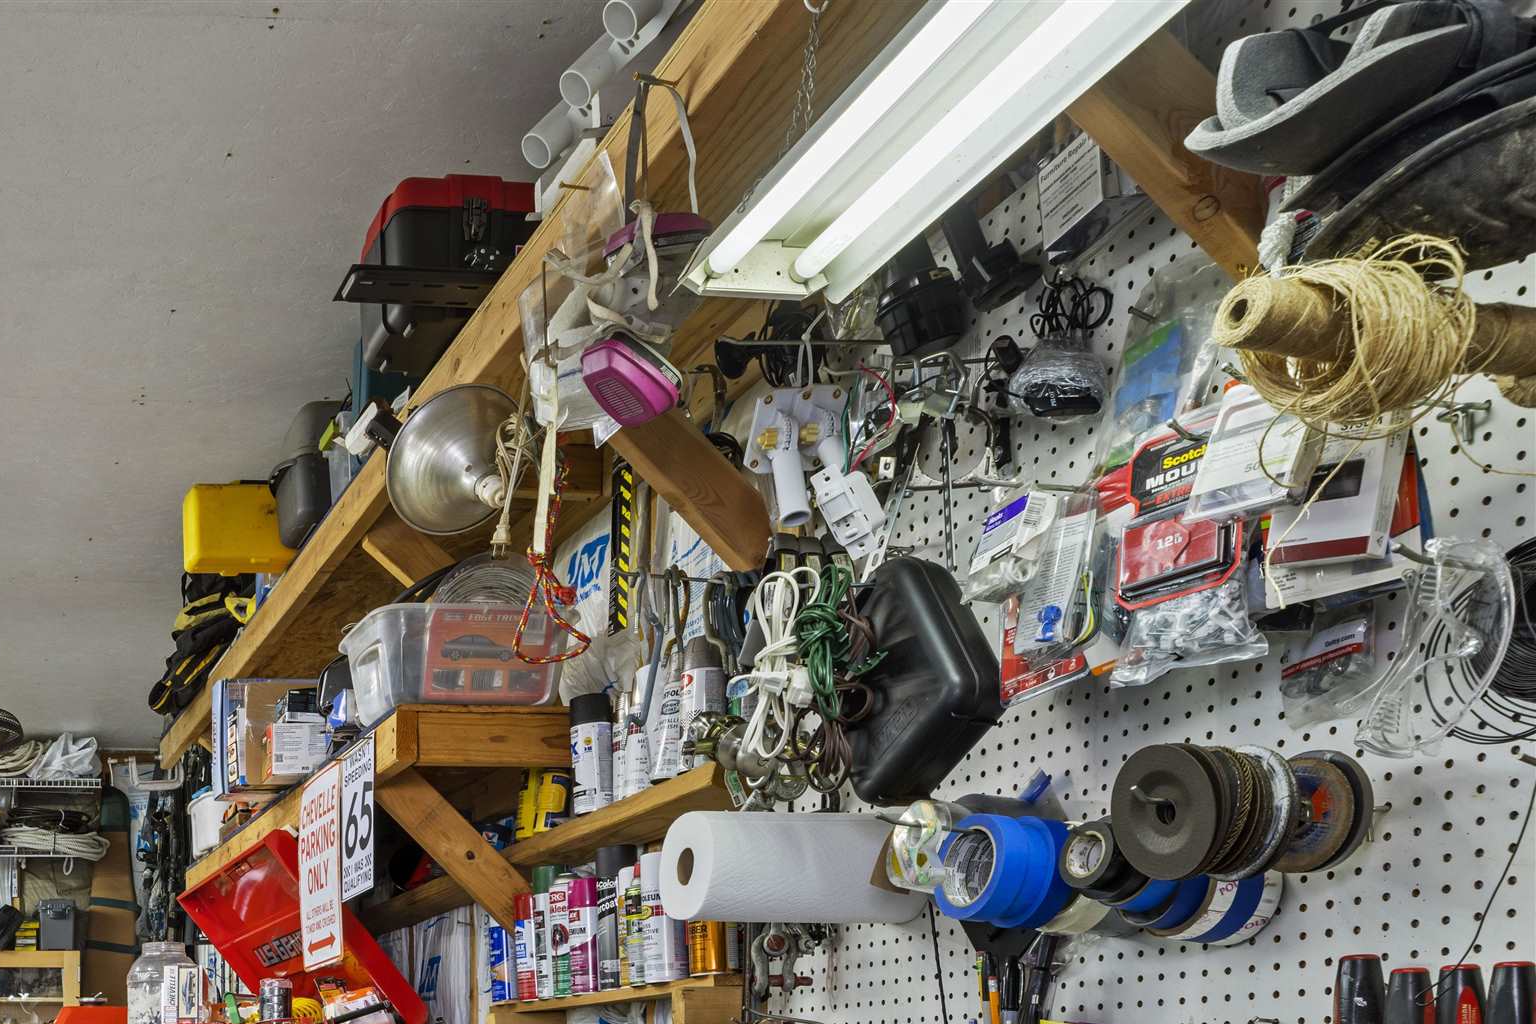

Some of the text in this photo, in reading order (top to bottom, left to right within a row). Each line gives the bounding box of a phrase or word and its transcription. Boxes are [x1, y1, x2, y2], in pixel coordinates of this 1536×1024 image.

[344, 758, 372, 788] SPEEDING
[301, 784, 336, 830] CHEVELLE
[344, 781, 373, 860] 65
[300, 818, 336, 865] PARKING
[307, 859, 330, 895] ONLY
[344, 868, 372, 894] QUALIFYING
[168, 978, 177, 1006] CHEVELLE
